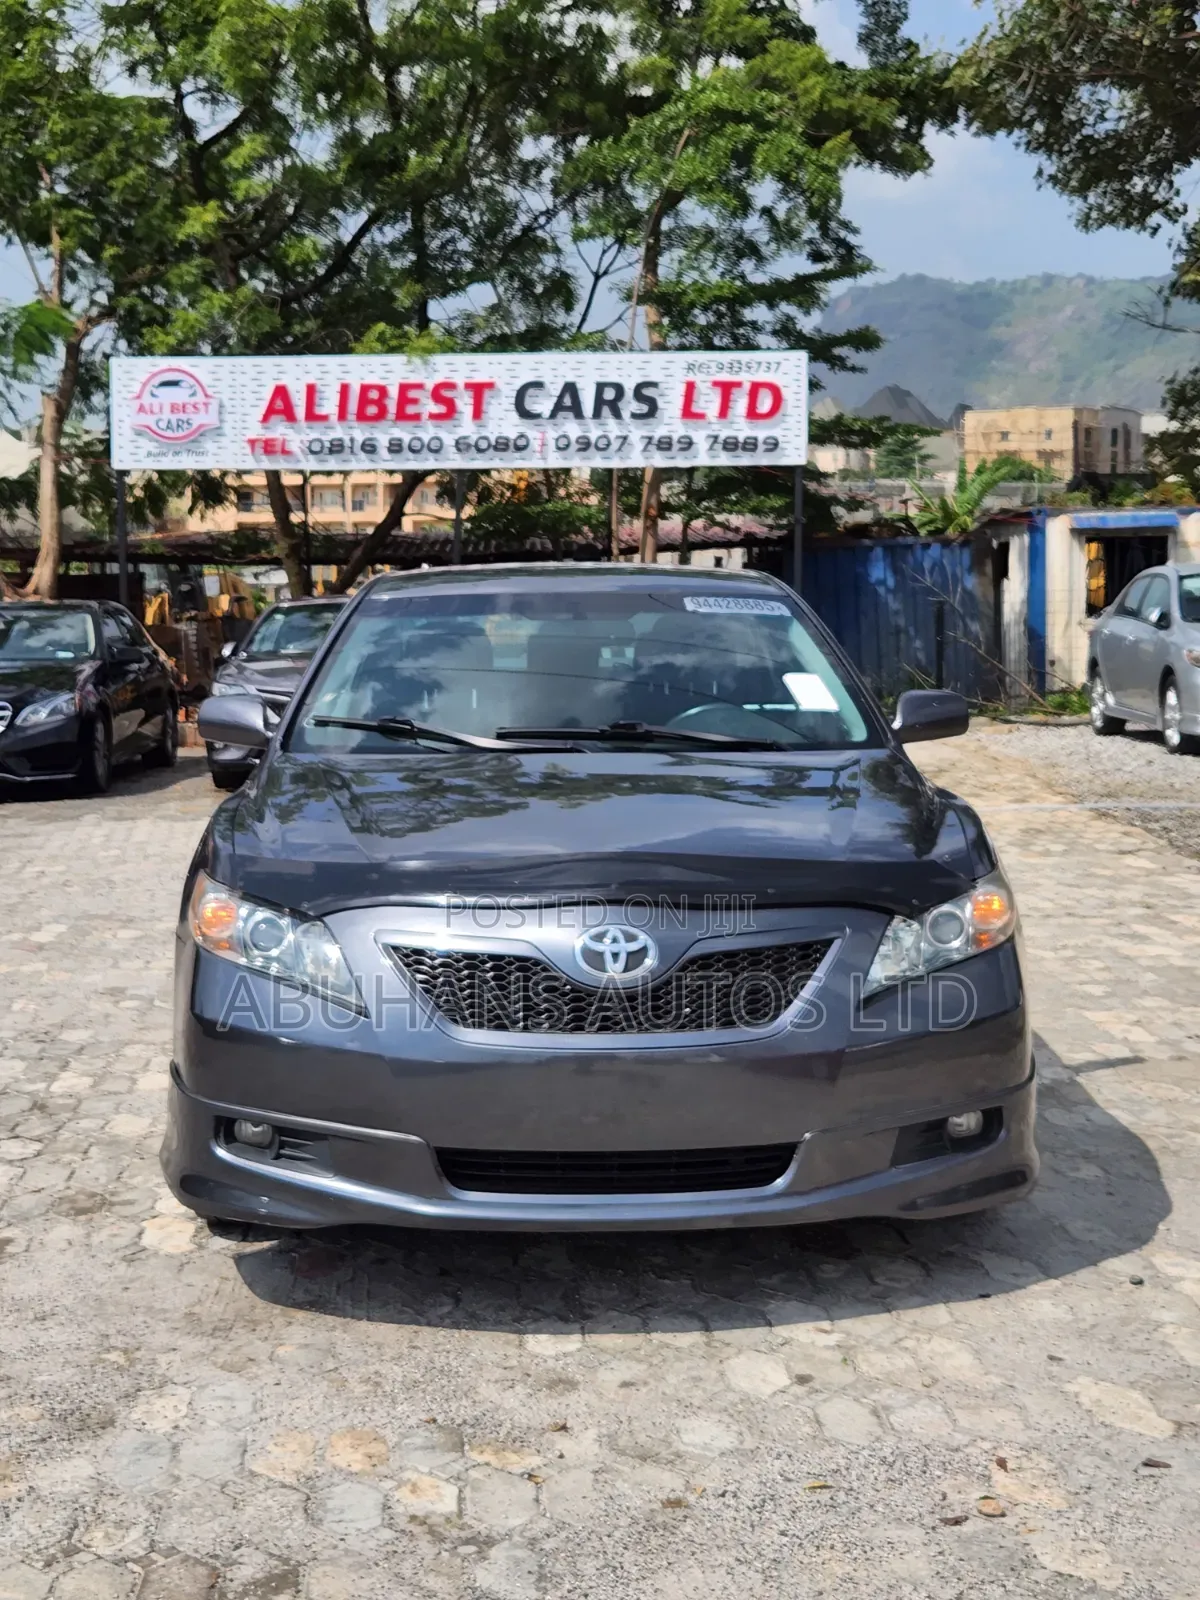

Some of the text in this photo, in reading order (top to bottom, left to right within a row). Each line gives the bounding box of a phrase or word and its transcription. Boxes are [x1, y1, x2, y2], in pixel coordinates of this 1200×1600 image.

[136, 402, 212, 415] ALI BEST
[260, 380, 785, 424] ALIBEST CARS LTD
[155, 418, 194, 433] CARS
[308, 436, 379, 455] 0816
[387, 436, 443, 454] 800
[454, 434, 531, 453] 6080
[555, 434, 629, 452] 0907
[640, 434, 694, 452] 789
[706, 434, 780, 452] 7889
